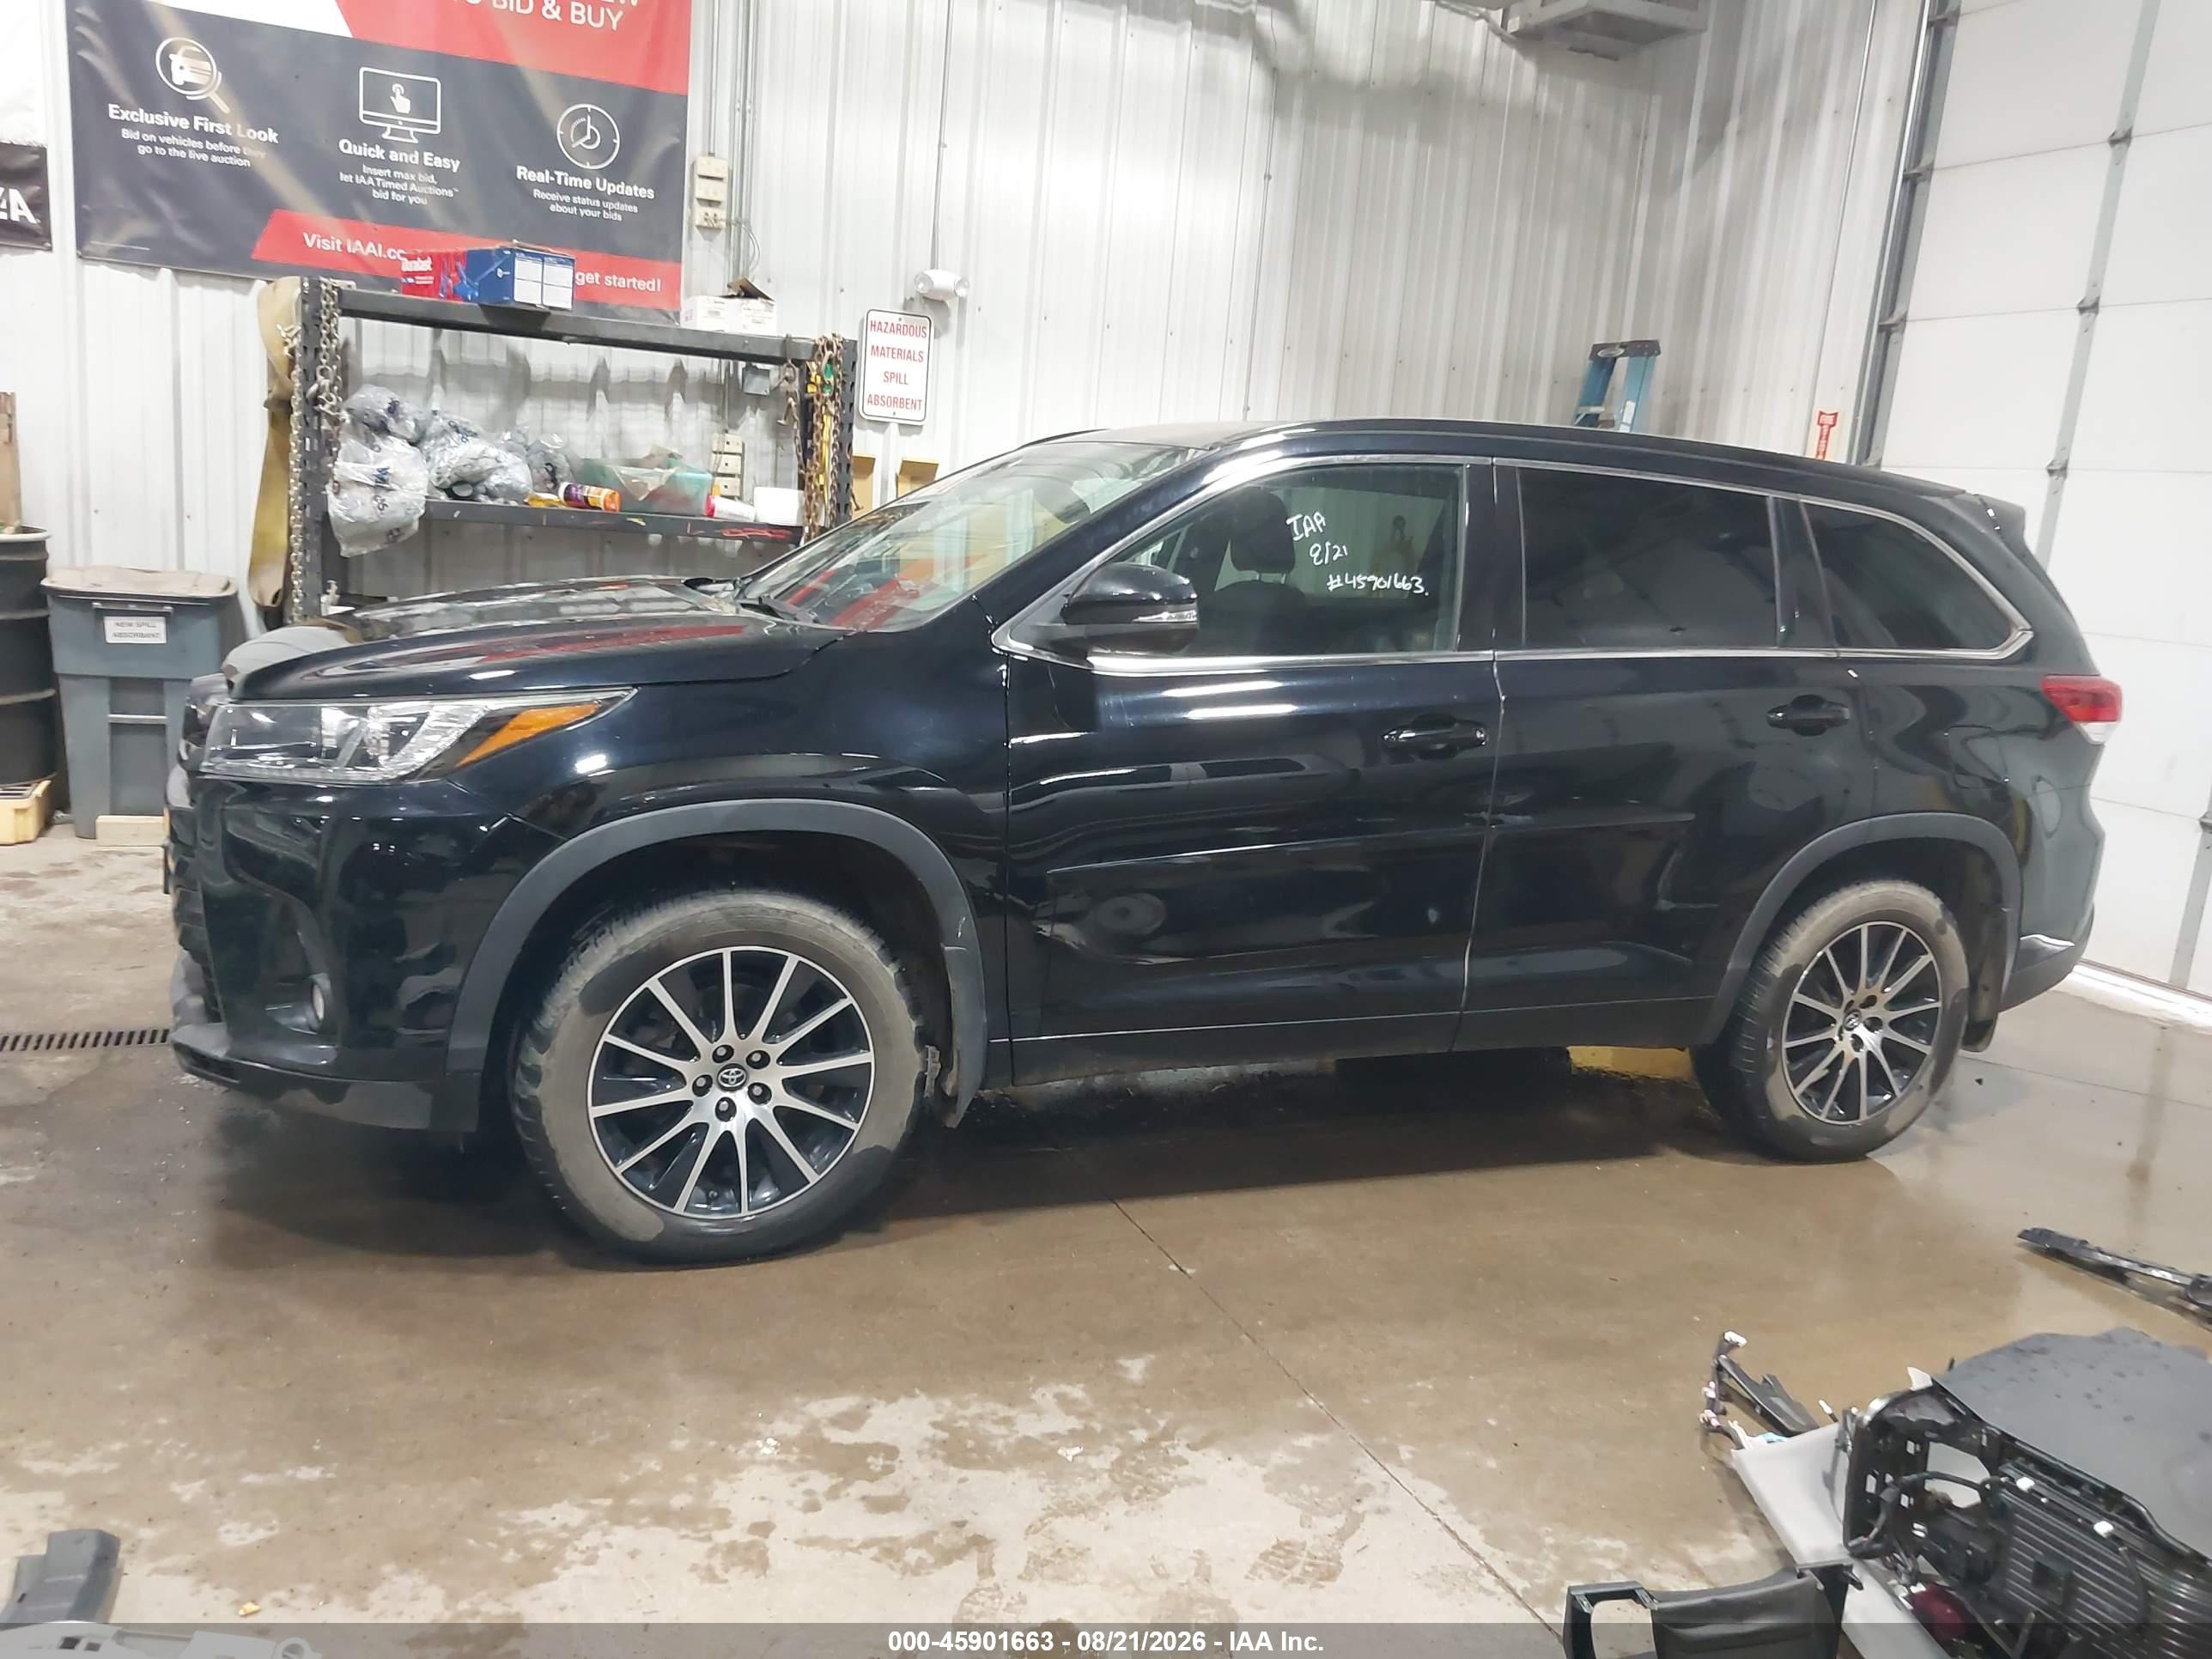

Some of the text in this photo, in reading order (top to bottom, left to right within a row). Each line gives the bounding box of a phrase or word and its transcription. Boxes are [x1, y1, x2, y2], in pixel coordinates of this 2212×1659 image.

[570, 2, 623, 31] BUY
[108, 104, 279, 144] Exclusive First Look
[121, 129, 140, 140] Bid
[142, 133, 156, 143] on
[158, 134, 204, 149] vehicles
[205, 140, 240, 155] before
[137, 144, 251, 167] go to the live auction
[338, 138, 460, 173] Quick and Easy
[355, 174, 374, 186] IAA
[376, 178, 408, 191] Timed
[362, 164, 392, 178] Insert
[393, 169, 416, 181] max
[516, 165, 655, 199] Real-Time Updates
[372, 189, 428, 205] bid for you
[532, 188, 638, 214] Receive status updates
[550, 203, 623, 222] about your bids
[303, 232, 343, 253] Visit
[575, 270, 662, 292] get started!
[870, 320, 927, 339] HAZARDOUS
[871, 344, 924, 362] MATERIALS
[883, 370, 909, 386] SPILL
[867, 393, 923, 411] ABSORBENT
[1285, 511, 1327, 541] IAA
